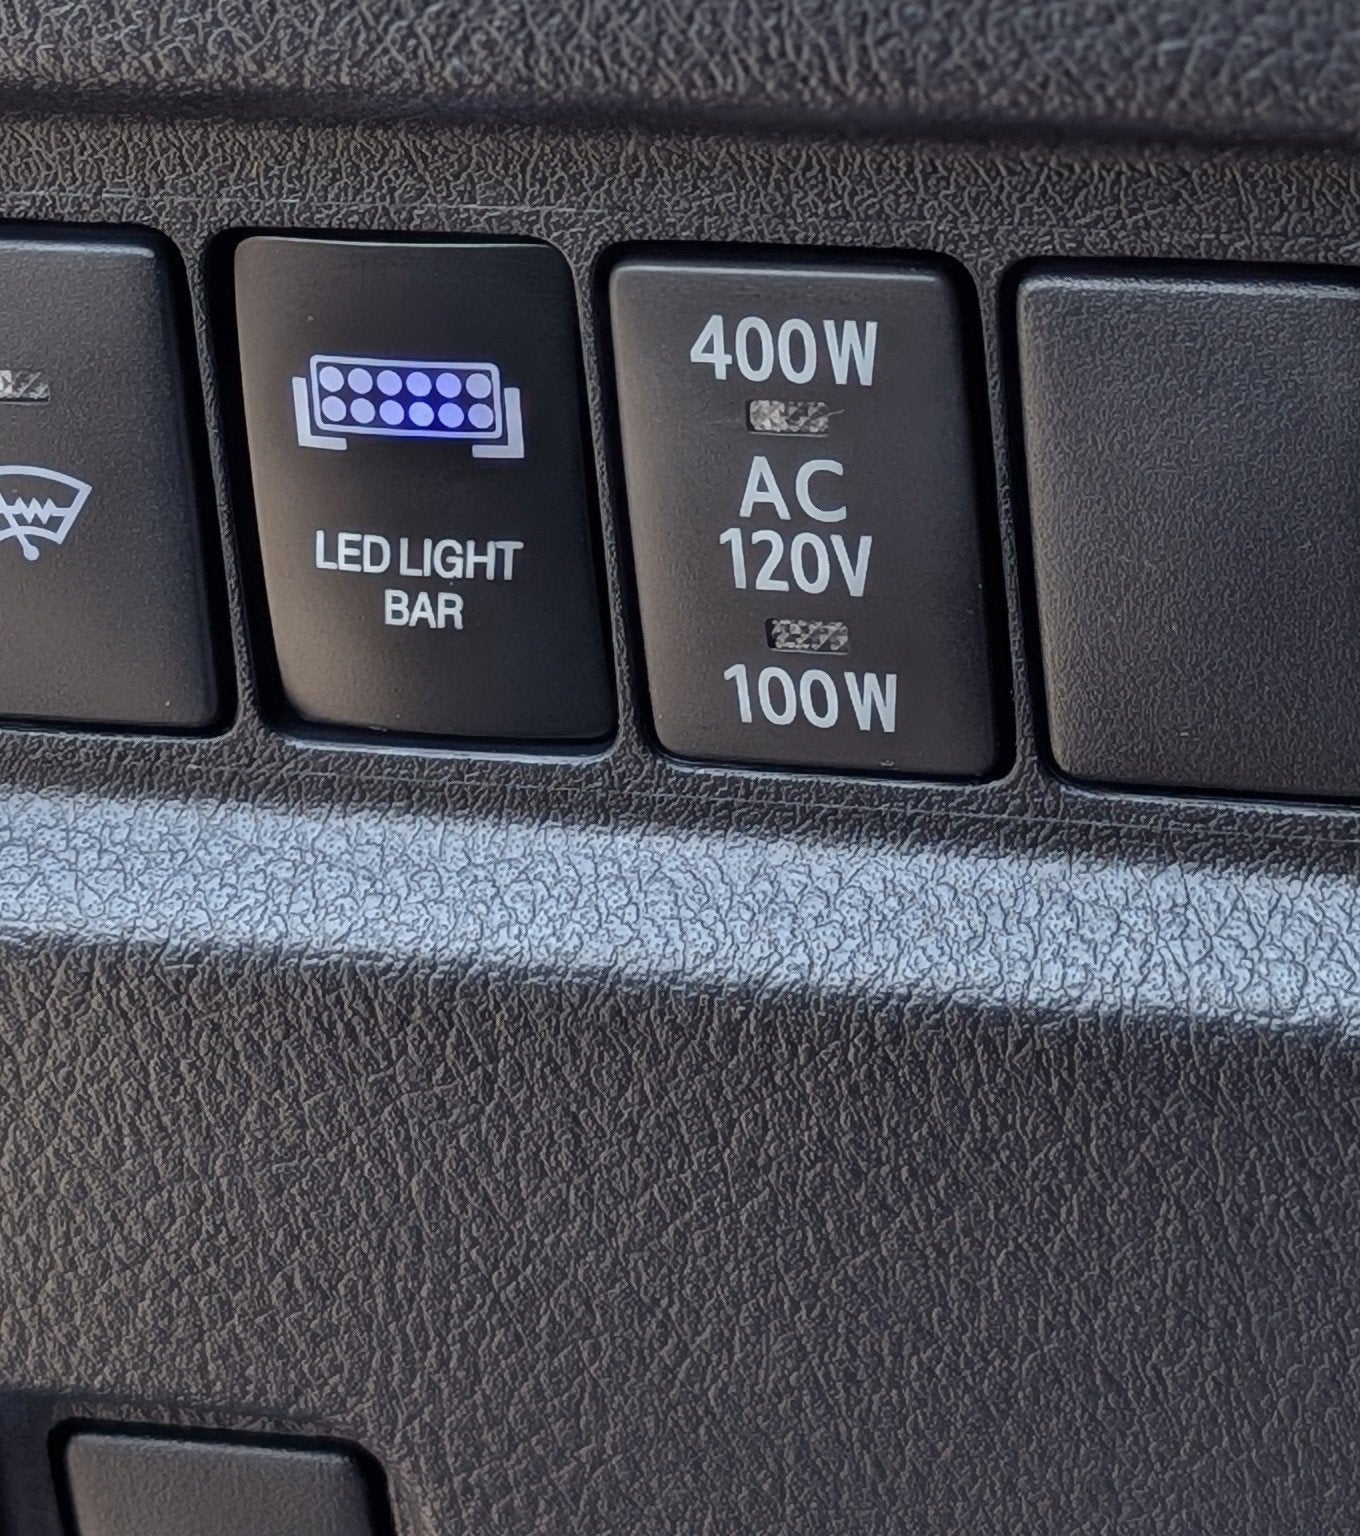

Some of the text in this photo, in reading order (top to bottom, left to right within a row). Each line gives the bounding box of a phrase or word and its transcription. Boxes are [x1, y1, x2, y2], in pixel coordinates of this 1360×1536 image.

[689, 314, 878, 387] 400W
[739, 455, 848, 524] AC
[314, 529, 524, 581] LED LIGHT
[718, 527, 873, 598] 120V
[383, 588, 464, 631] BAR
[723, 663, 898, 734] 100W
